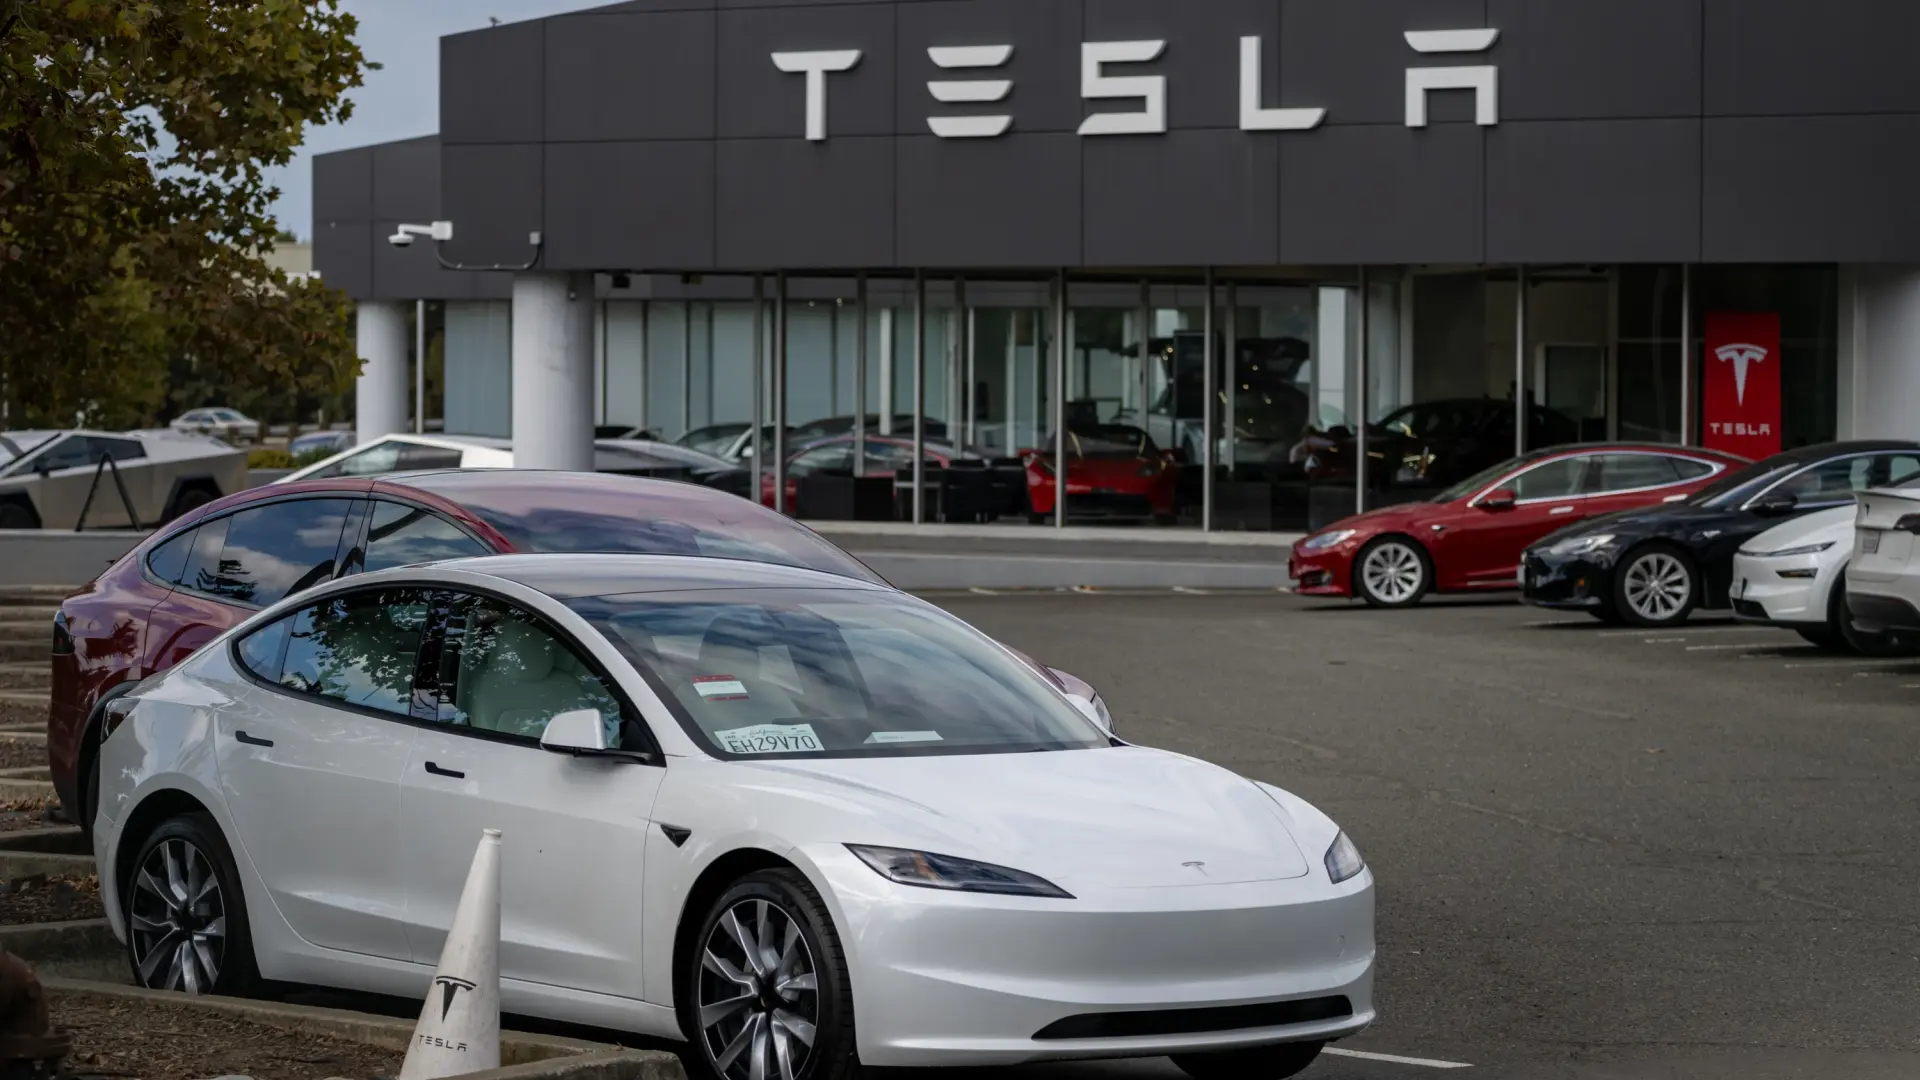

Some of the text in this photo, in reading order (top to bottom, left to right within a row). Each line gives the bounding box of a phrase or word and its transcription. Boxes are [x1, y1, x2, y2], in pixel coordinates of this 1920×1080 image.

[771, 28, 1498, 141] TESLA
[1710, 422, 1771, 436] TESLA
[419, 1034, 468, 1052] TESLA
